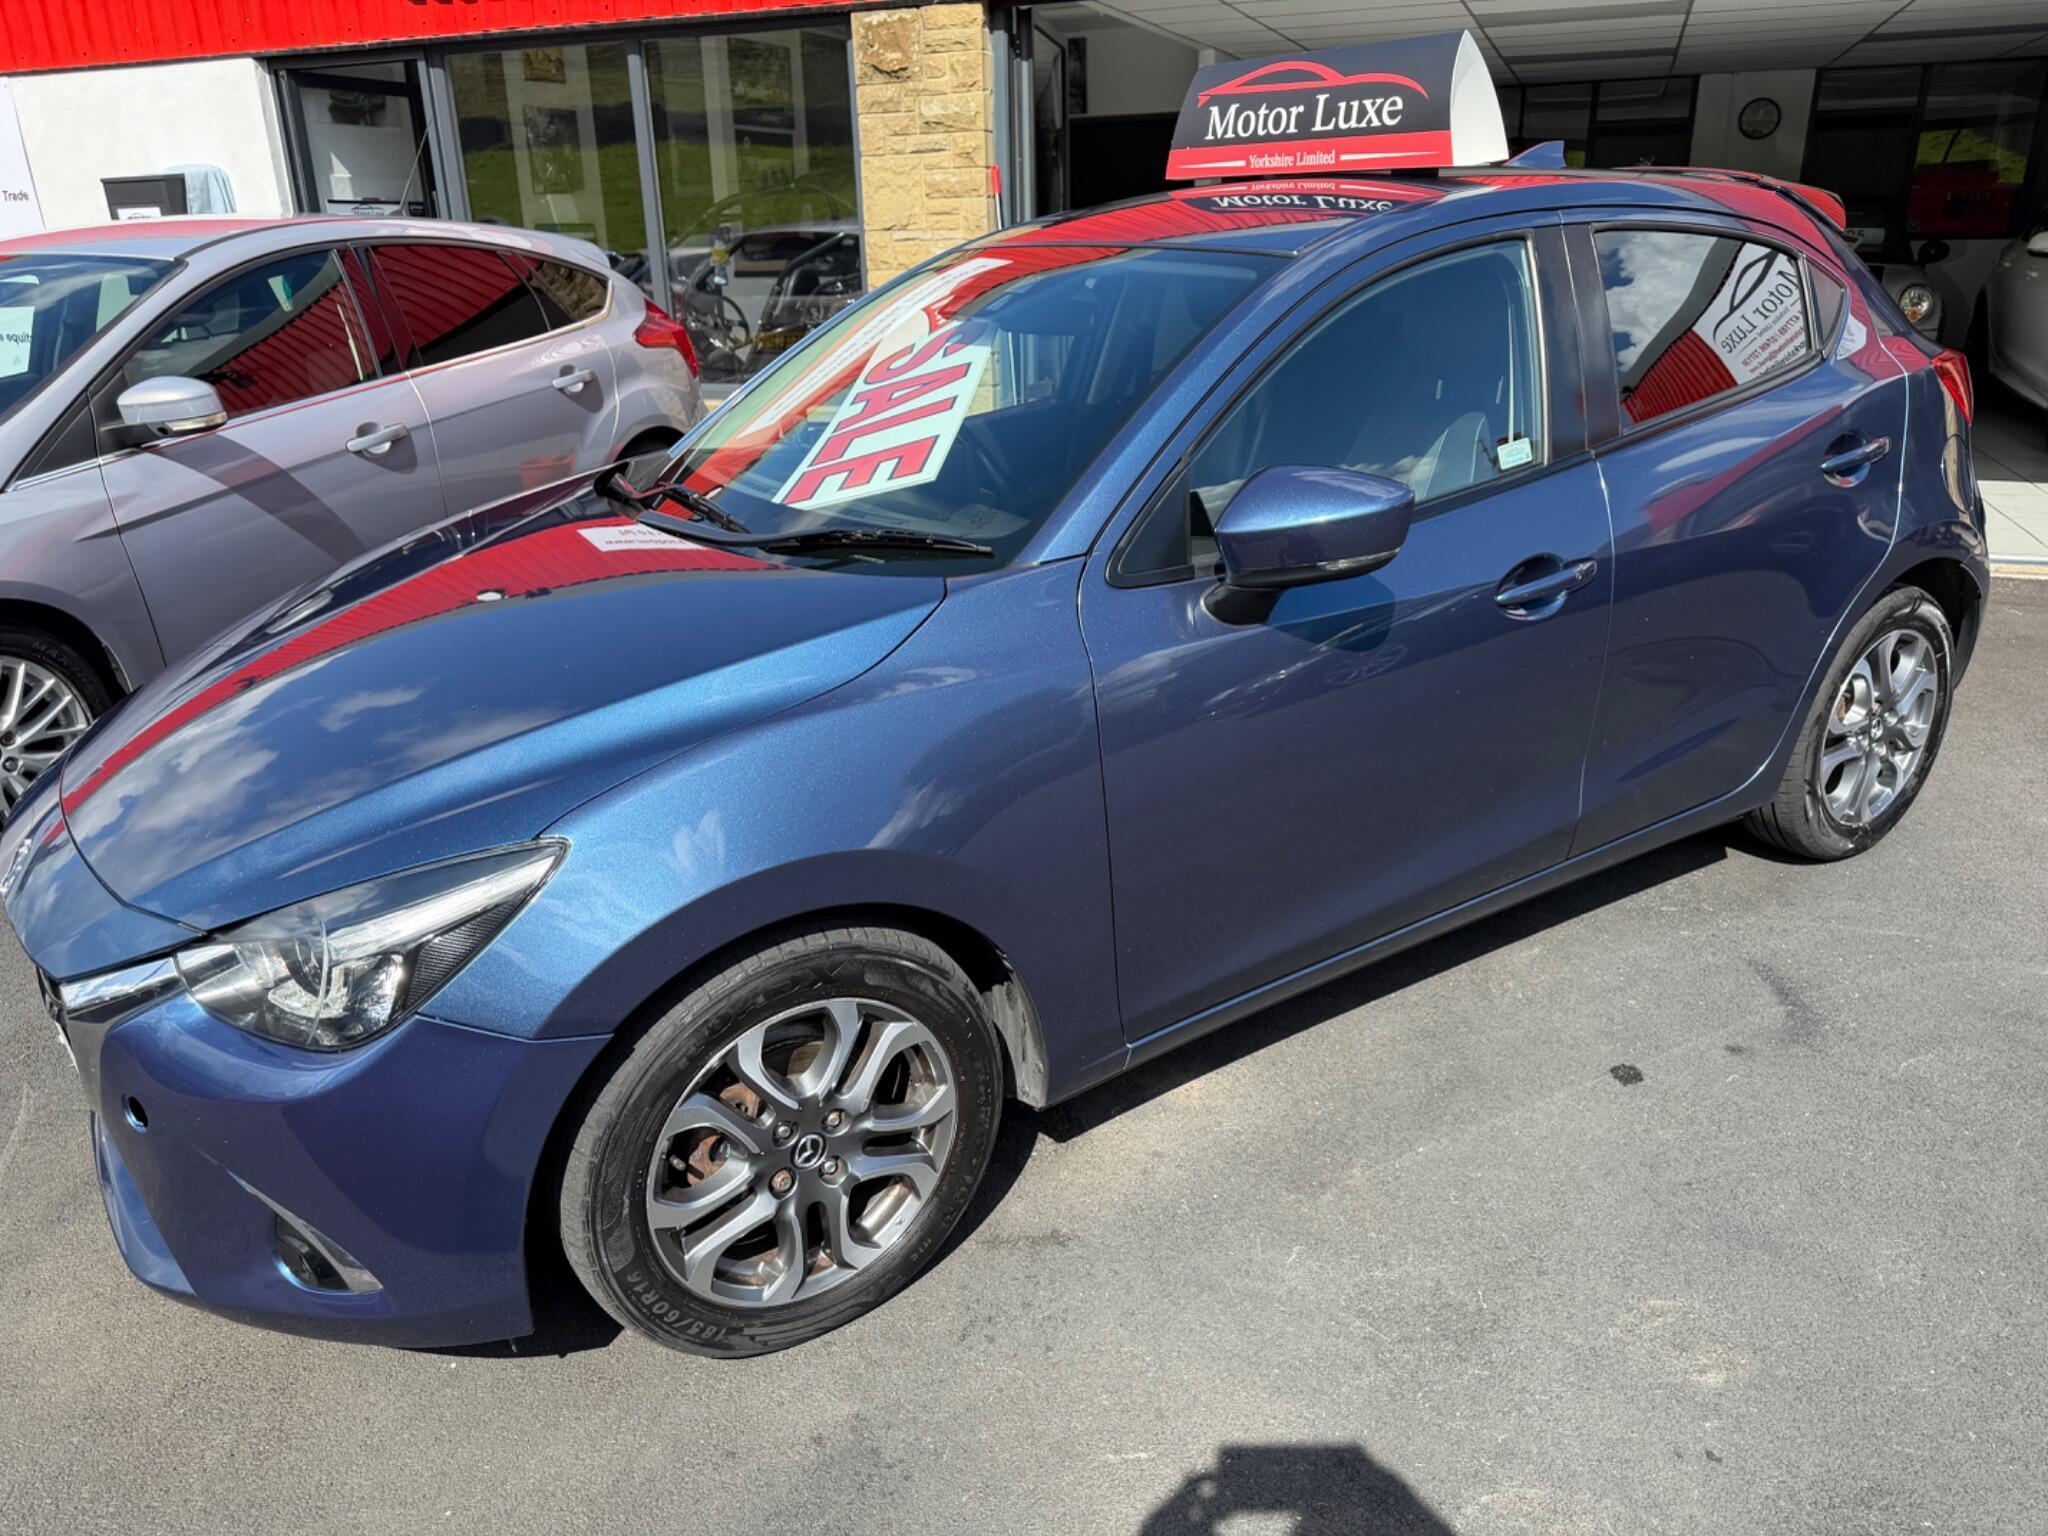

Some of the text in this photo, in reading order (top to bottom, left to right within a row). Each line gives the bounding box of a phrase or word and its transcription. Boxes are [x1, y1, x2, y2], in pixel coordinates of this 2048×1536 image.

[1204, 94, 1404, 140] Motor Luxe
[1249, 150, 1336, 169] Yorkshire Limited
[2, 189, 29, 202] Trade
[782, 319, 989, 506] SALE
[627, 1269, 729, 1342] 185/60R16
